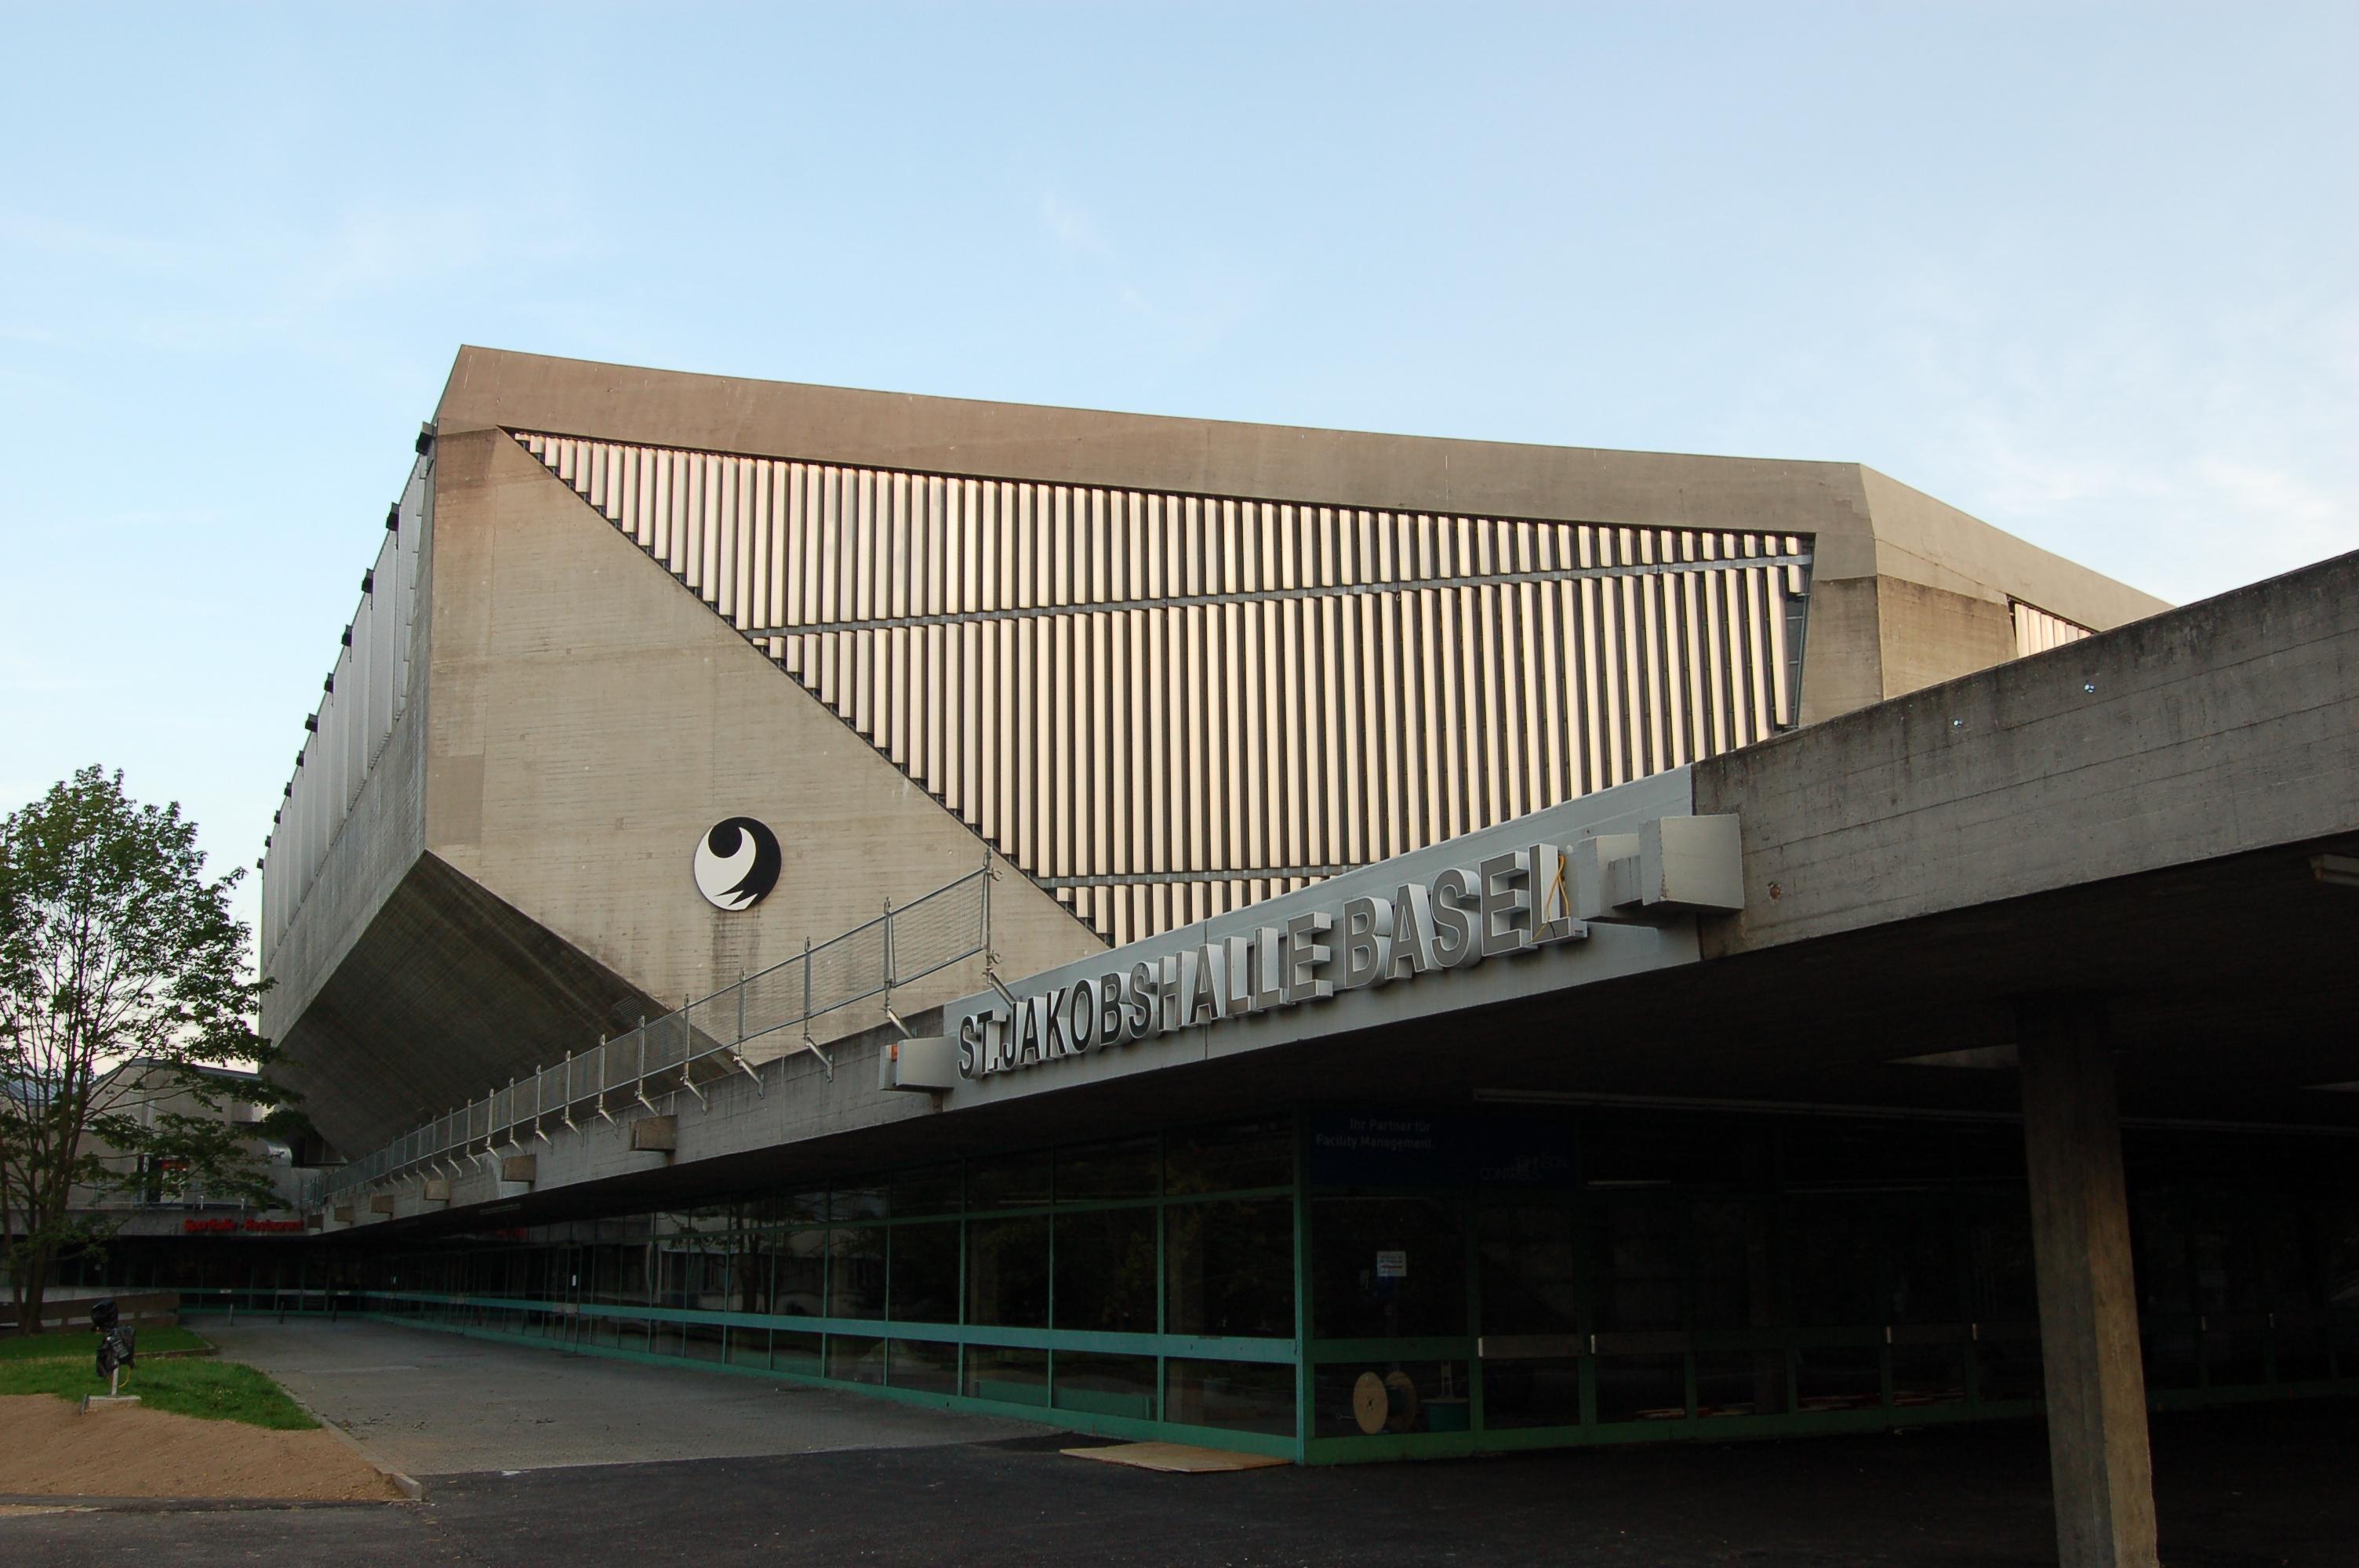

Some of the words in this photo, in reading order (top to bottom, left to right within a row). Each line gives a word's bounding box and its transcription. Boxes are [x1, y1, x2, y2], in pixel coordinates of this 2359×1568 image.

[1343, 843, 1587, 989] BASEL
[1349, 1117, 1366, 1130] Ihr
[1369, 1119, 1412, 1131] Partner
[1316, 1134, 1357, 1149] Facility
